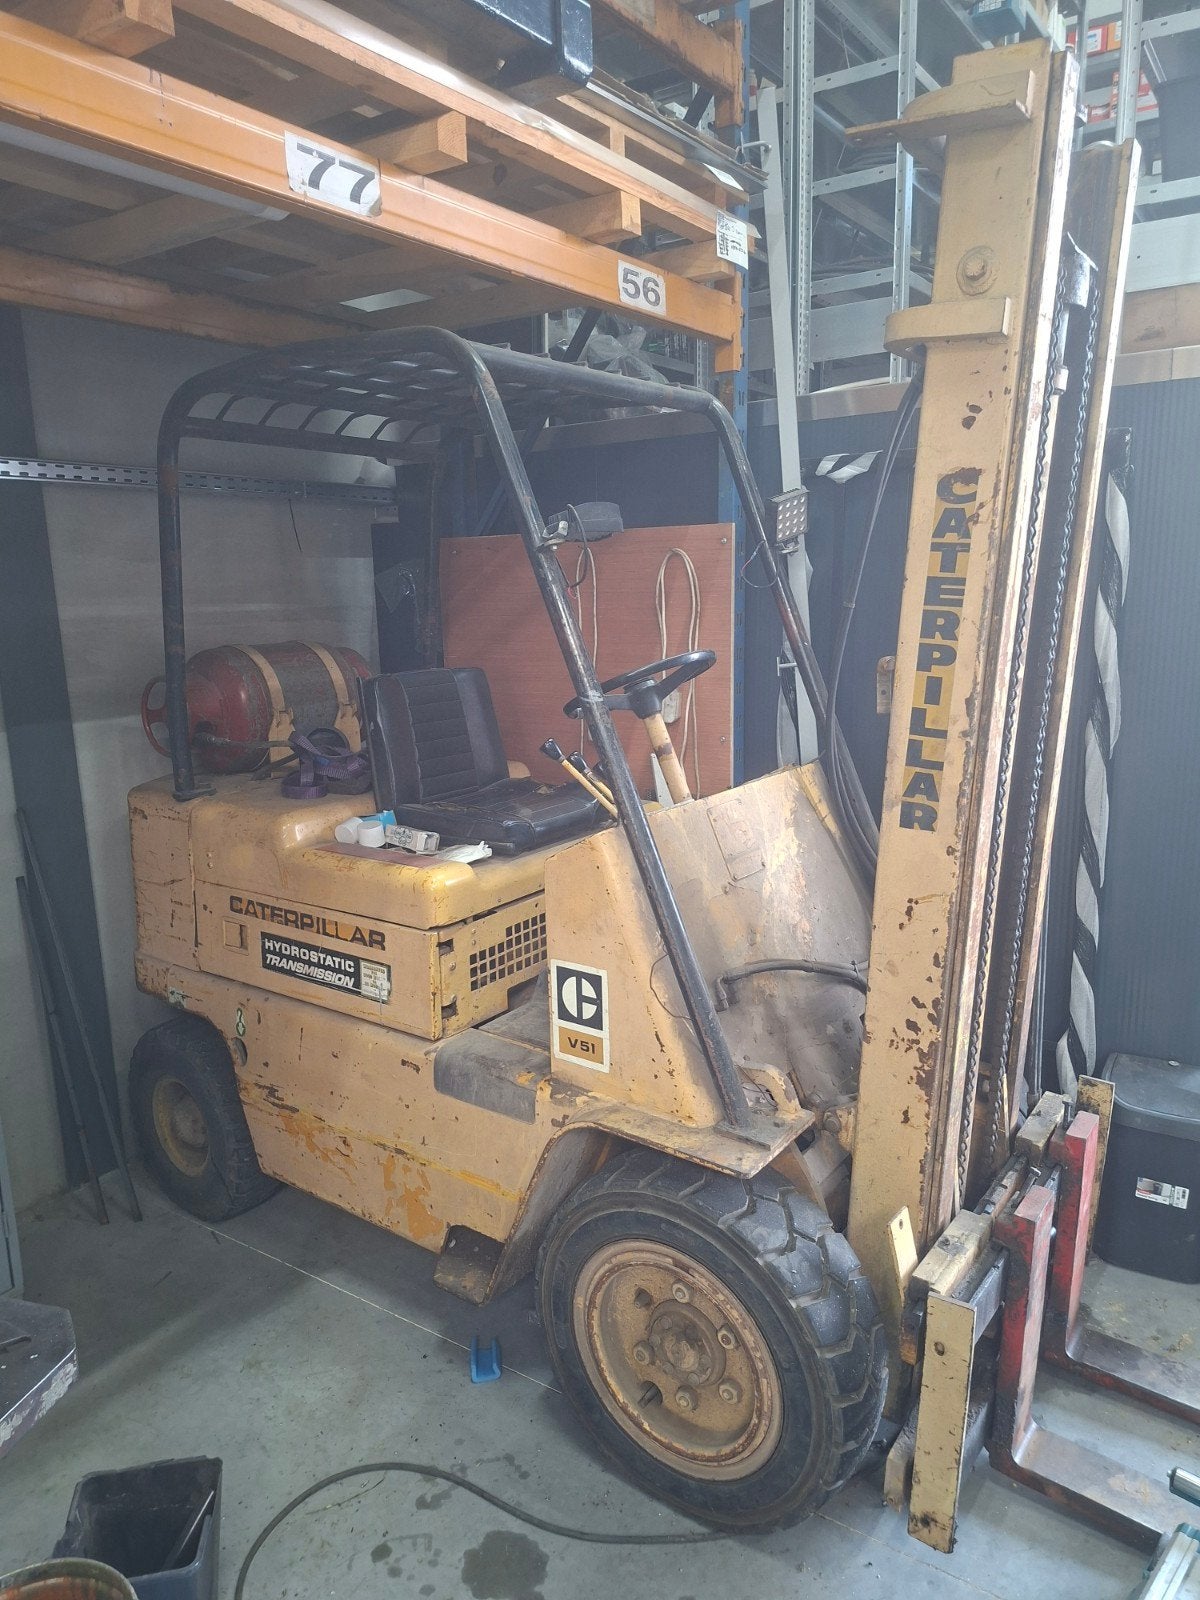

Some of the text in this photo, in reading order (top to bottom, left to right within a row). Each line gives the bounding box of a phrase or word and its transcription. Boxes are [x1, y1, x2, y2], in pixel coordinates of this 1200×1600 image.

[297, 142, 375, 204] 77
[622, 267, 660, 306] 56
[899, 467, 980, 832] CATERPILLAR
[230, 895, 386, 951] CATERPILLAR
[265, 938, 355, 973] HYDROSTATIC
[265, 953, 355, 990] TRANSMISSION
[567, 1036, 596, 1055] V51
